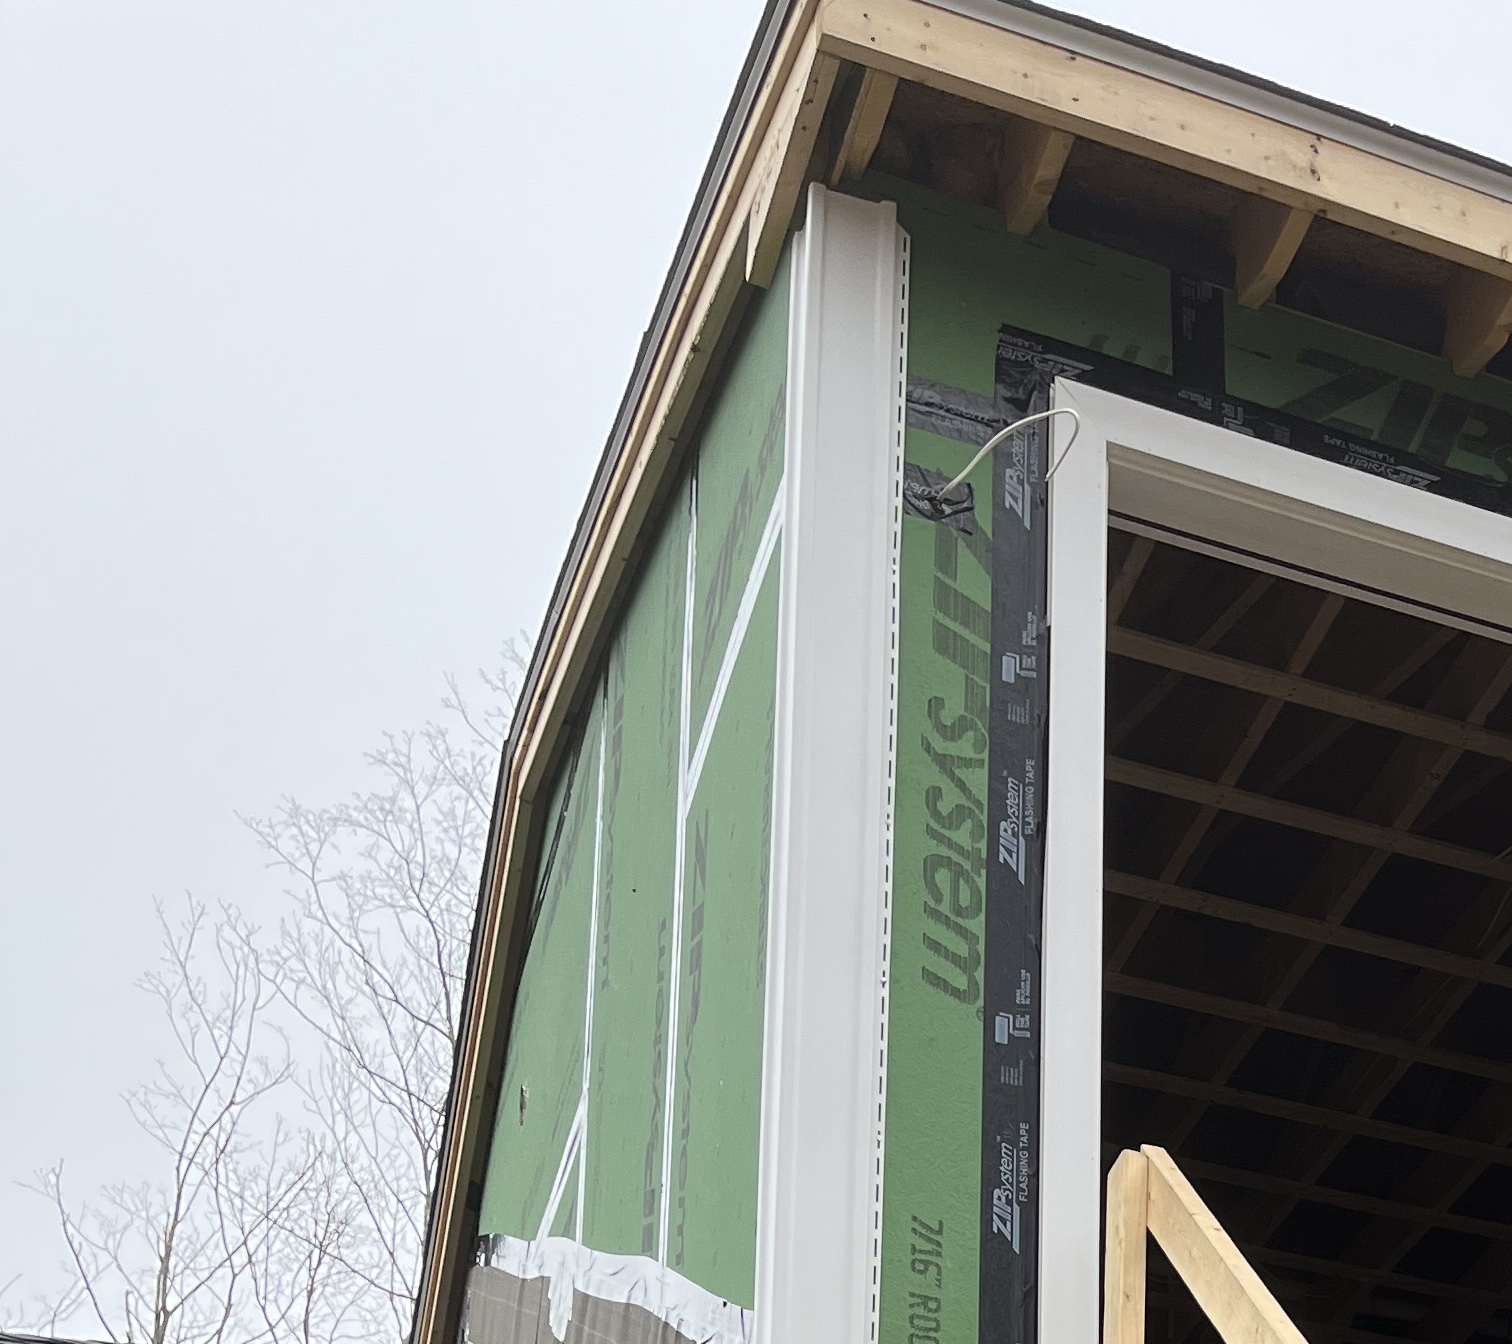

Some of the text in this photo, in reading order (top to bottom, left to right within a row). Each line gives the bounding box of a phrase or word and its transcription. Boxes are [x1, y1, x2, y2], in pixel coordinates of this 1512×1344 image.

[999, 776, 1020, 873] ZIPsystem
[1024, 758, 1037, 837] FLASHING TAPE
[992, 1141, 1014, 1244] ZIPsystem
[1018, 1121, 1030, 1203] FLASHING TAPE
[909, 1213, 944, 1289] 7/16"
